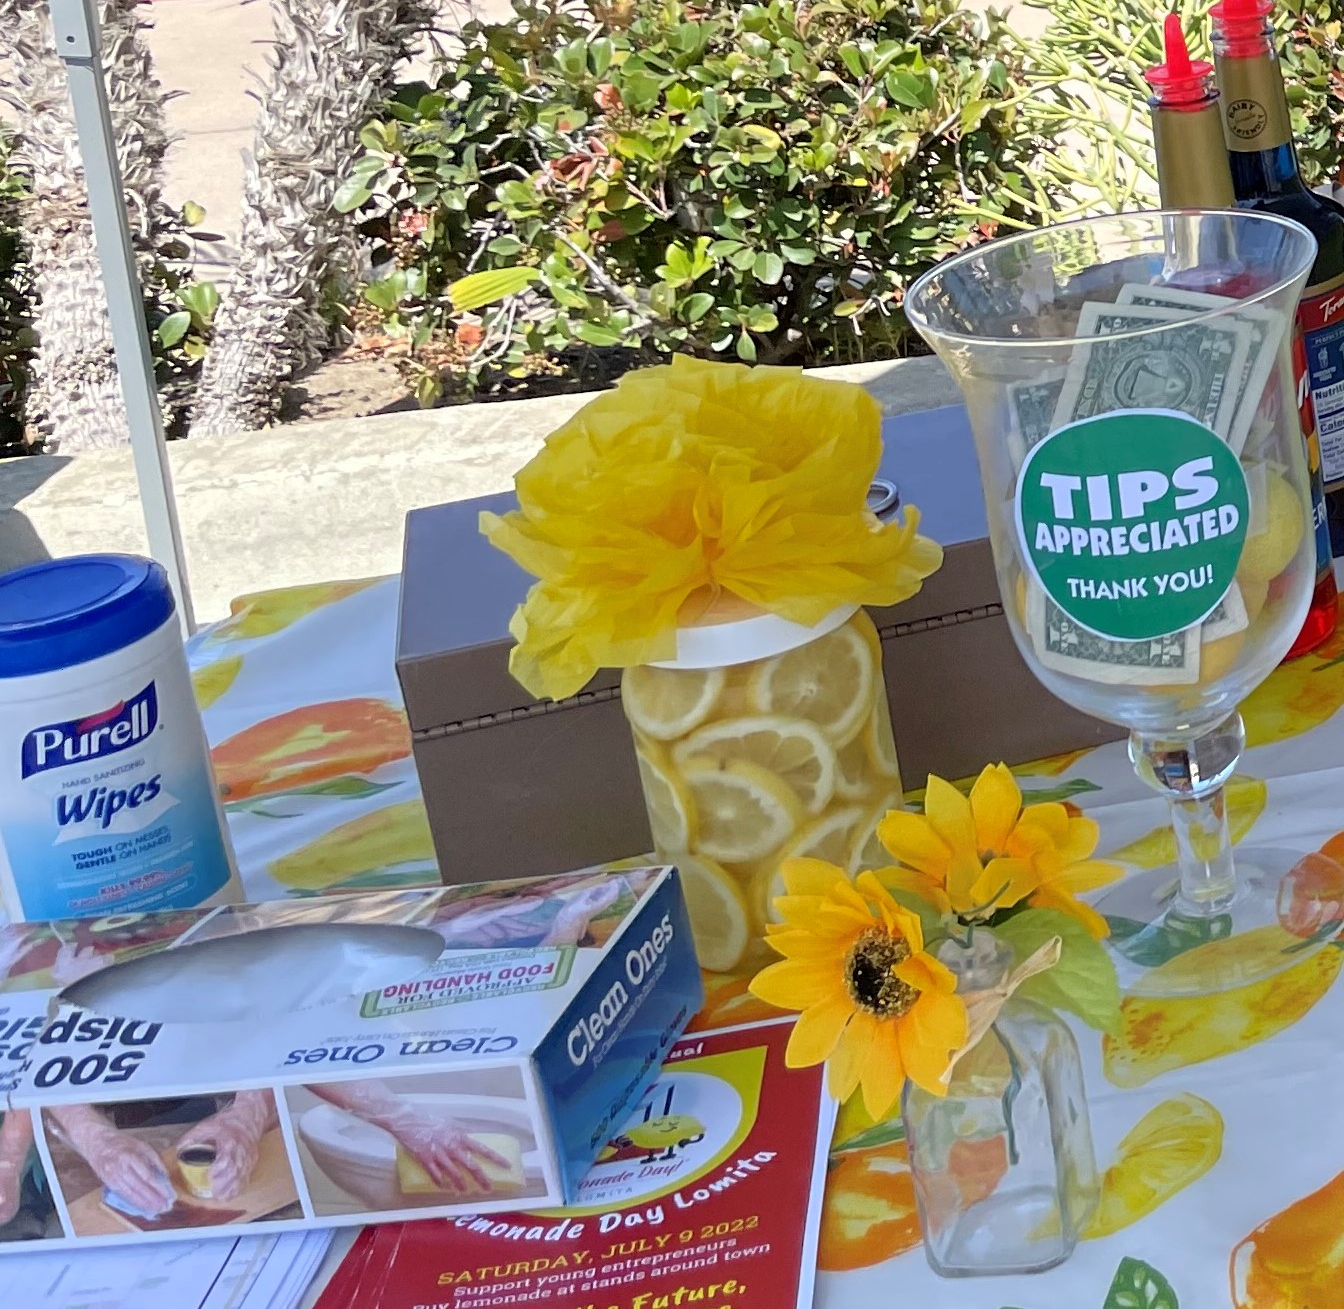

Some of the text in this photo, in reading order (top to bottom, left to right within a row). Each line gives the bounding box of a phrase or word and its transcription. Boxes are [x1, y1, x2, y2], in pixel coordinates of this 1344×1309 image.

[1040, 456, 1219, 521] TIPS
[1035, 504, 1239, 556] APPRECIATED
[1067, 564, 1214, 600] THANK YOU!
[33, 699, 148, 765] Purell
[63, 758, 145, 789] HAND SANITIZING
[57, 774, 161, 829] Wipes
[383, 962, 555, 998] FOOD HANDLING
[566, 980, 629, 1067] Clean
[625, 912, 673, 985] Ones
[34, 1051, 146, 1088] 500
[283, 1043, 385, 1065] Ones
[400, 1035, 518, 1056] Clean
[599, 1206, 664, 1234] Day
[675, 1149, 777, 1208] Lomita
[437, 1216, 759, 1285] SATURDAY, JULY 9 2022
[453, 1238, 737, 1298] Support young entrepreneurs
[455, 1243, 771, 1309] lemonade at stands around town
